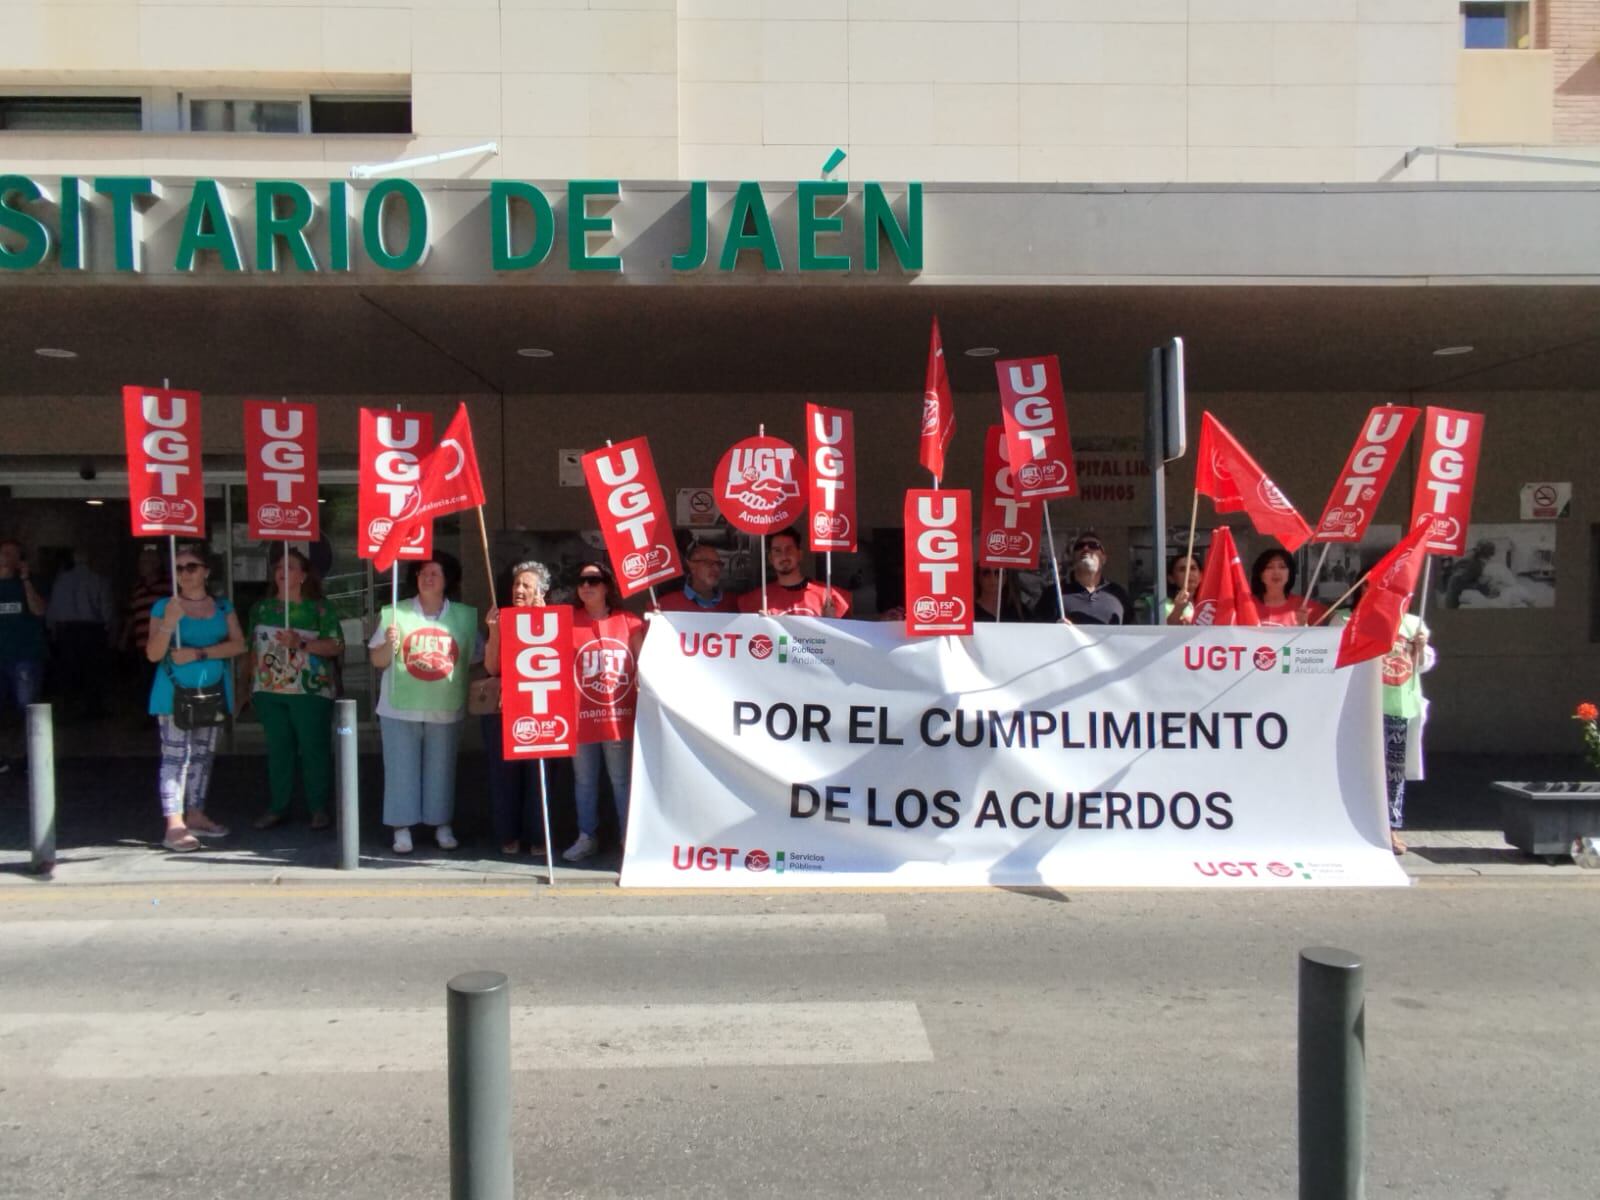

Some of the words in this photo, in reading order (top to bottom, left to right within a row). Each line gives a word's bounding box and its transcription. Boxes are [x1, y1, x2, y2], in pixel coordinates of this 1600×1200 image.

[0, 174, 430, 271] SITARIO
[491, 181, 621, 271] DE
[671, 147, 924, 272] JAÉN
[1009, 363, 1056, 460] UGT
[142, 395, 190, 496] UGT
[260, 409, 305, 503] UGT
[728, 447, 796, 485] UGT
[814, 412, 845, 511] UGT
[1344, 413, 1404, 506] UGT
[1427, 415, 1470, 515] UGT
[596, 447, 655, 550] UGT
[1080, 485, 1135, 500] HUMOS
[917, 497, 959, 595] UGT
[940, 601, 955, 610] FSP
[410, 634, 453, 656] UGT
[515, 612, 561, 715] UGT
[582, 648, 628, 677] UGT
[679, 632, 743, 659] UGT
[1184, 645, 1248, 671] UGT
[541, 720, 557, 729] FSP
[733, 701, 831, 743] POR
[849, 706, 904, 746] EL
[920, 707, 1289, 750] CUMPLIMIENTO
[790, 783, 851, 823] DE
[867, 787, 960, 829] LOS
[974, 790, 1235, 831] ACUERDOS
[672, 845, 740, 872] UGT
[789, 852, 825, 862] Servicios
[1193, 861, 1259, 878] UGT
